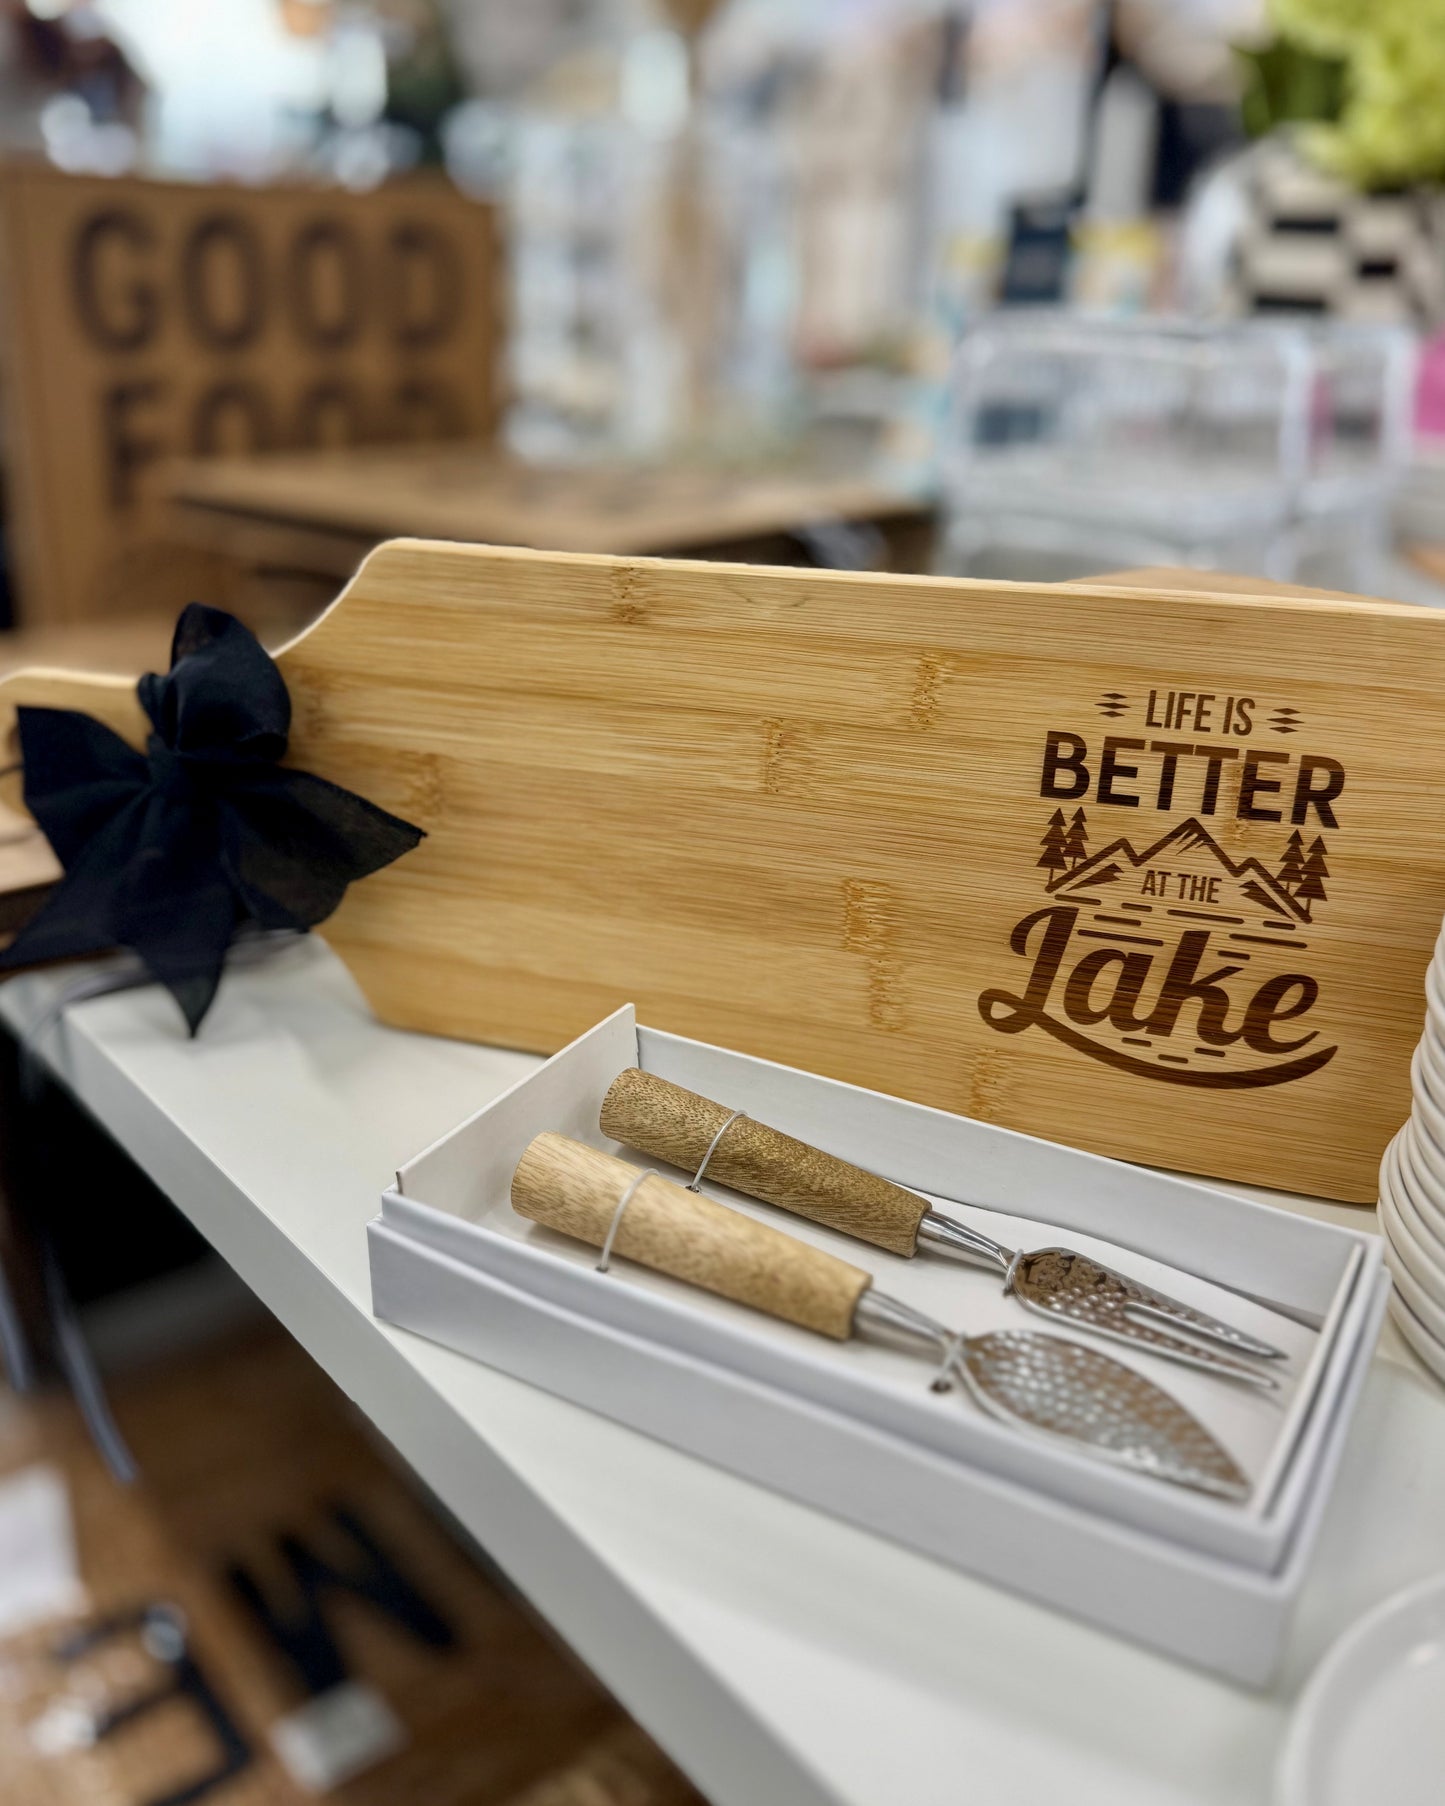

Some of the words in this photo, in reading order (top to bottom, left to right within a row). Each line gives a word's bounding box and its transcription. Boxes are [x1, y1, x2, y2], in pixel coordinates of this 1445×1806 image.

[70, 207, 464, 355] GOOD
[1145, 689, 1216, 733] LIFE
[1222, 696, 1256, 736] IS
[1040, 730, 1346, 829] BETTER
[1141, 870, 1171, 897] AT
[1178, 873, 1223, 903] THE
[977, 906, 1339, 1089] Lake
